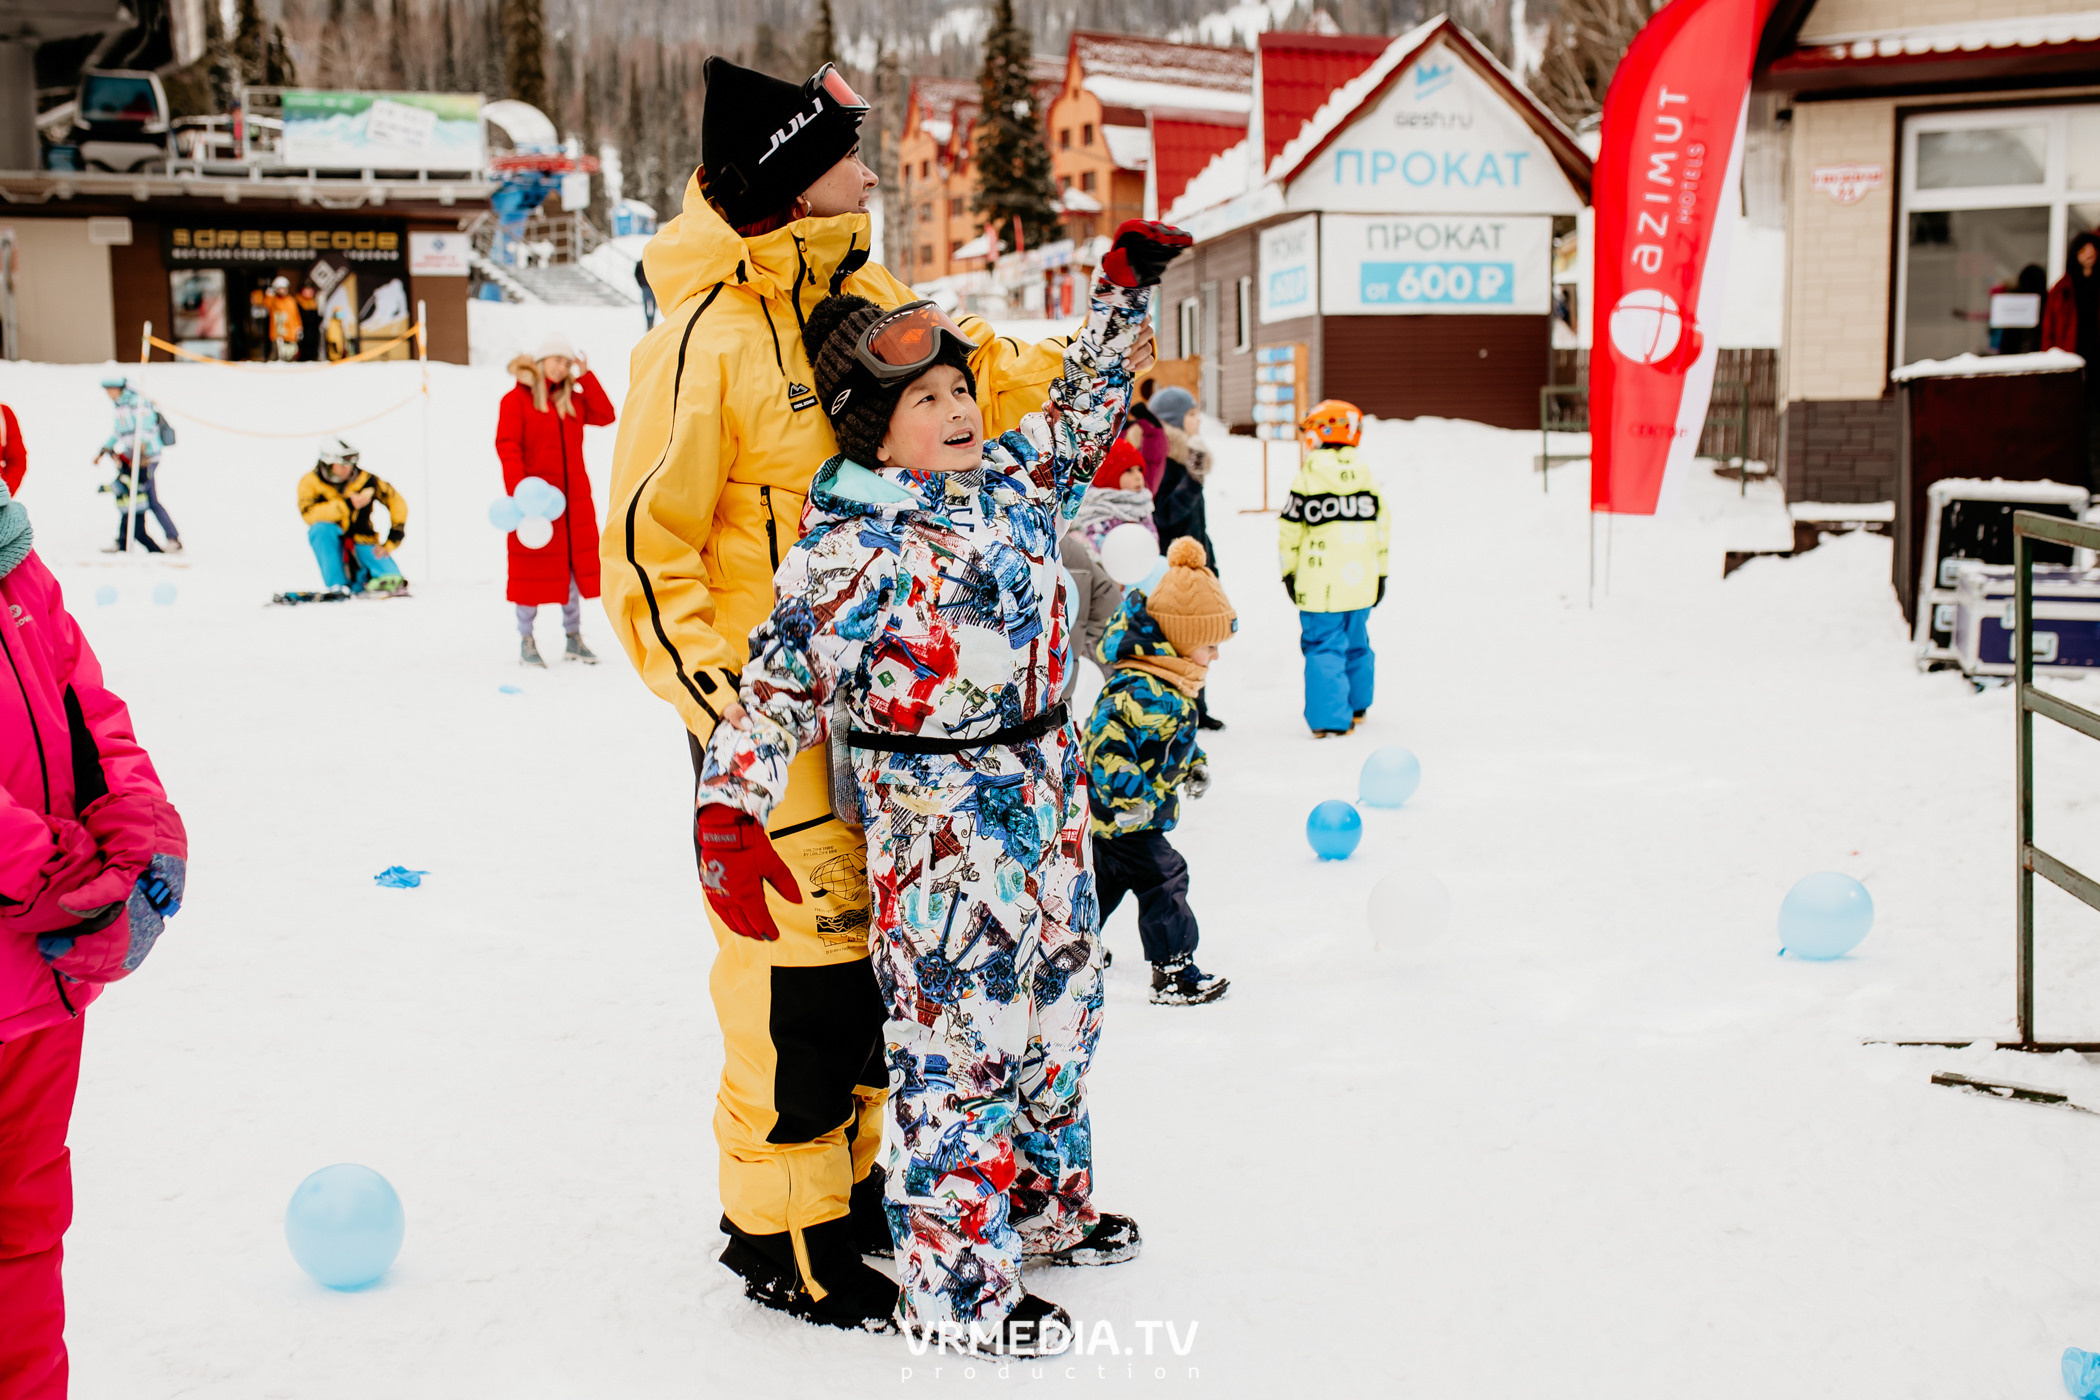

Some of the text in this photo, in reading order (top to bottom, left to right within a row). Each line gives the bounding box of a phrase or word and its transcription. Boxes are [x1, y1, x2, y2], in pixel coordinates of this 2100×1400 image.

[1334, 150, 1530, 187] ПРОКАТ
[1676, 143, 1706, 225] HOTELS
[1367, 223, 1506, 250] ПРОКАТ
[1365, 282, 1390, 300] от
[1304, 495, 1376, 523] COUS
